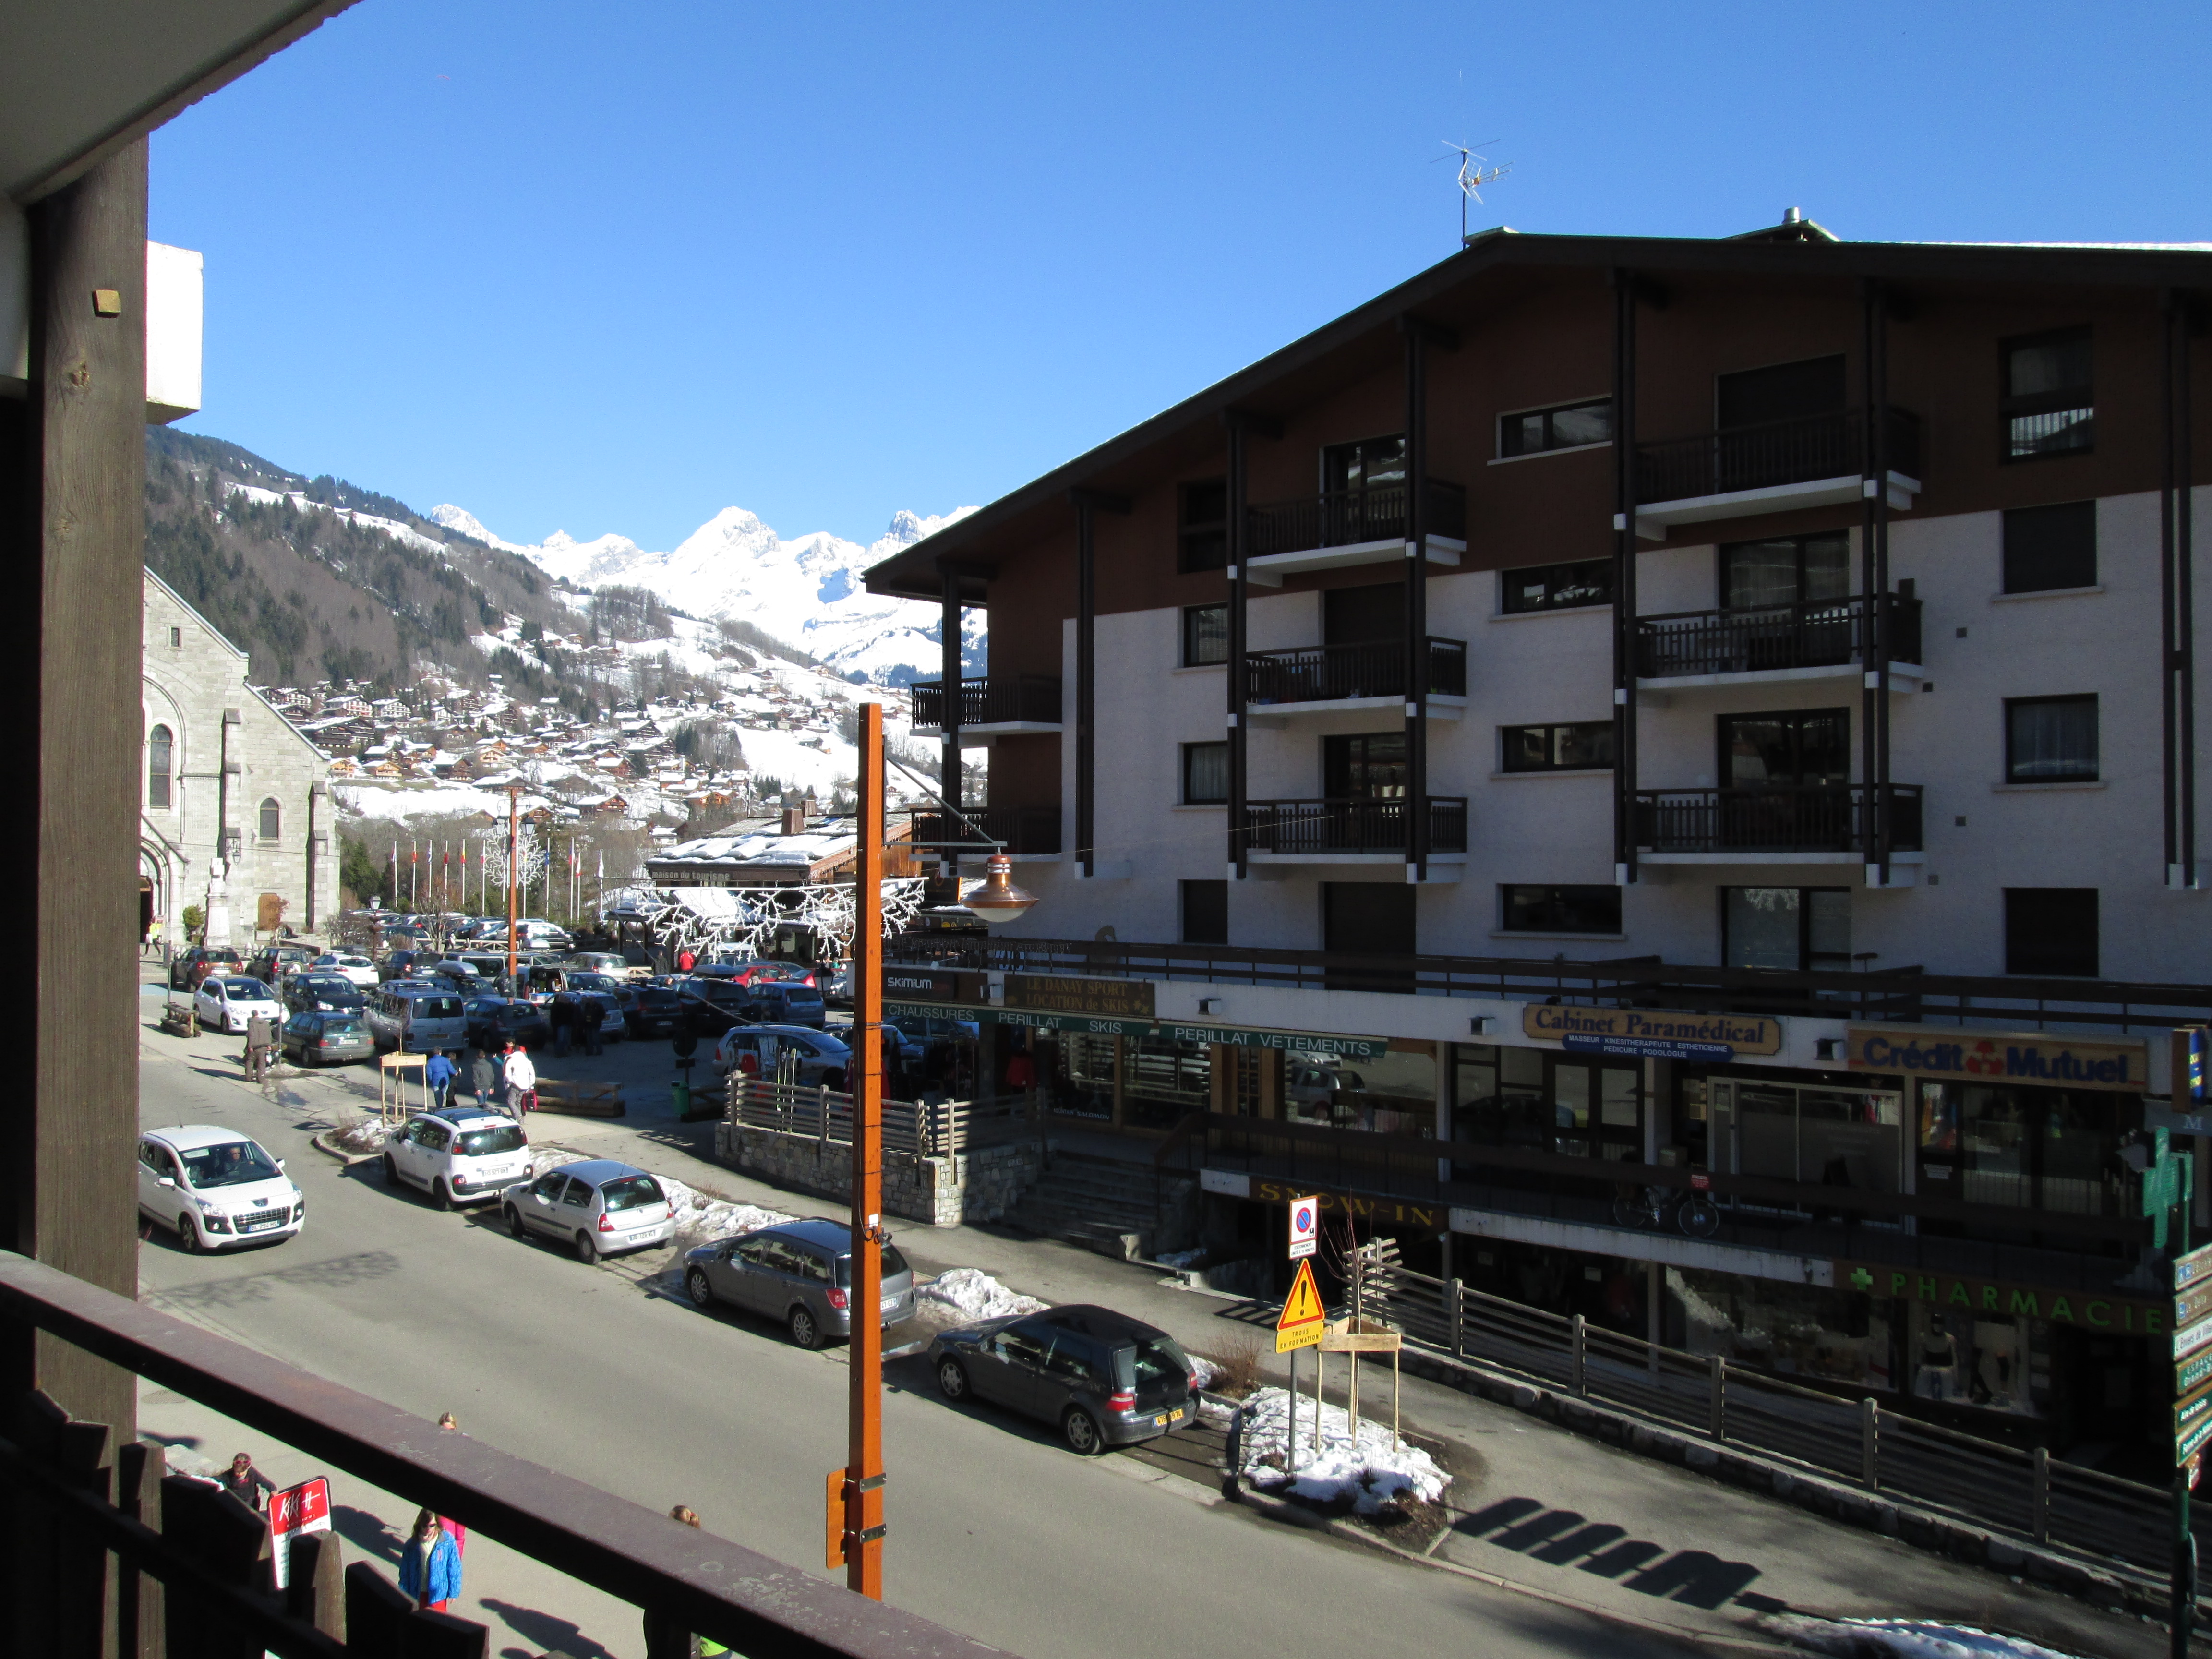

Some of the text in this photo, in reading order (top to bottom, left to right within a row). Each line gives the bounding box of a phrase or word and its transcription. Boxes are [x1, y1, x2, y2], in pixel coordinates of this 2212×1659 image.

[651, 870, 731, 881] maison du tourisme
[1026, 977, 1128, 996] LE DANAY SPORT
[888, 1004, 974, 1021] CHAUSSURES
[1026, 993, 1129, 1013] LOCATION de SKIS
[998, 1012, 1122, 1034] PERILLAT SKIS
[1536, 1008, 1764, 1043] Cabinet Paramédical
[1175, 1027, 1371, 1056] PERILLAT VETEMENTS
[1569, 1034, 1728, 1052] MASSEUR KINESITHERAPEUTE ESTHETICIENNE
[1603, 1045, 1687, 1058] PEDICURE PODOLOGUE
[1863, 1037, 2128, 1084] Crédit Mutuel
[1076, 1111, 1110, 1120] SALOMON
[1259, 1184, 1434, 1226] SNOW-IN
[1891, 1272, 2162, 1334] PHARMACIE
[1289, 1334, 1319, 1347] FORMATION
[1292, 1328, 1309, 1338] TROUS
